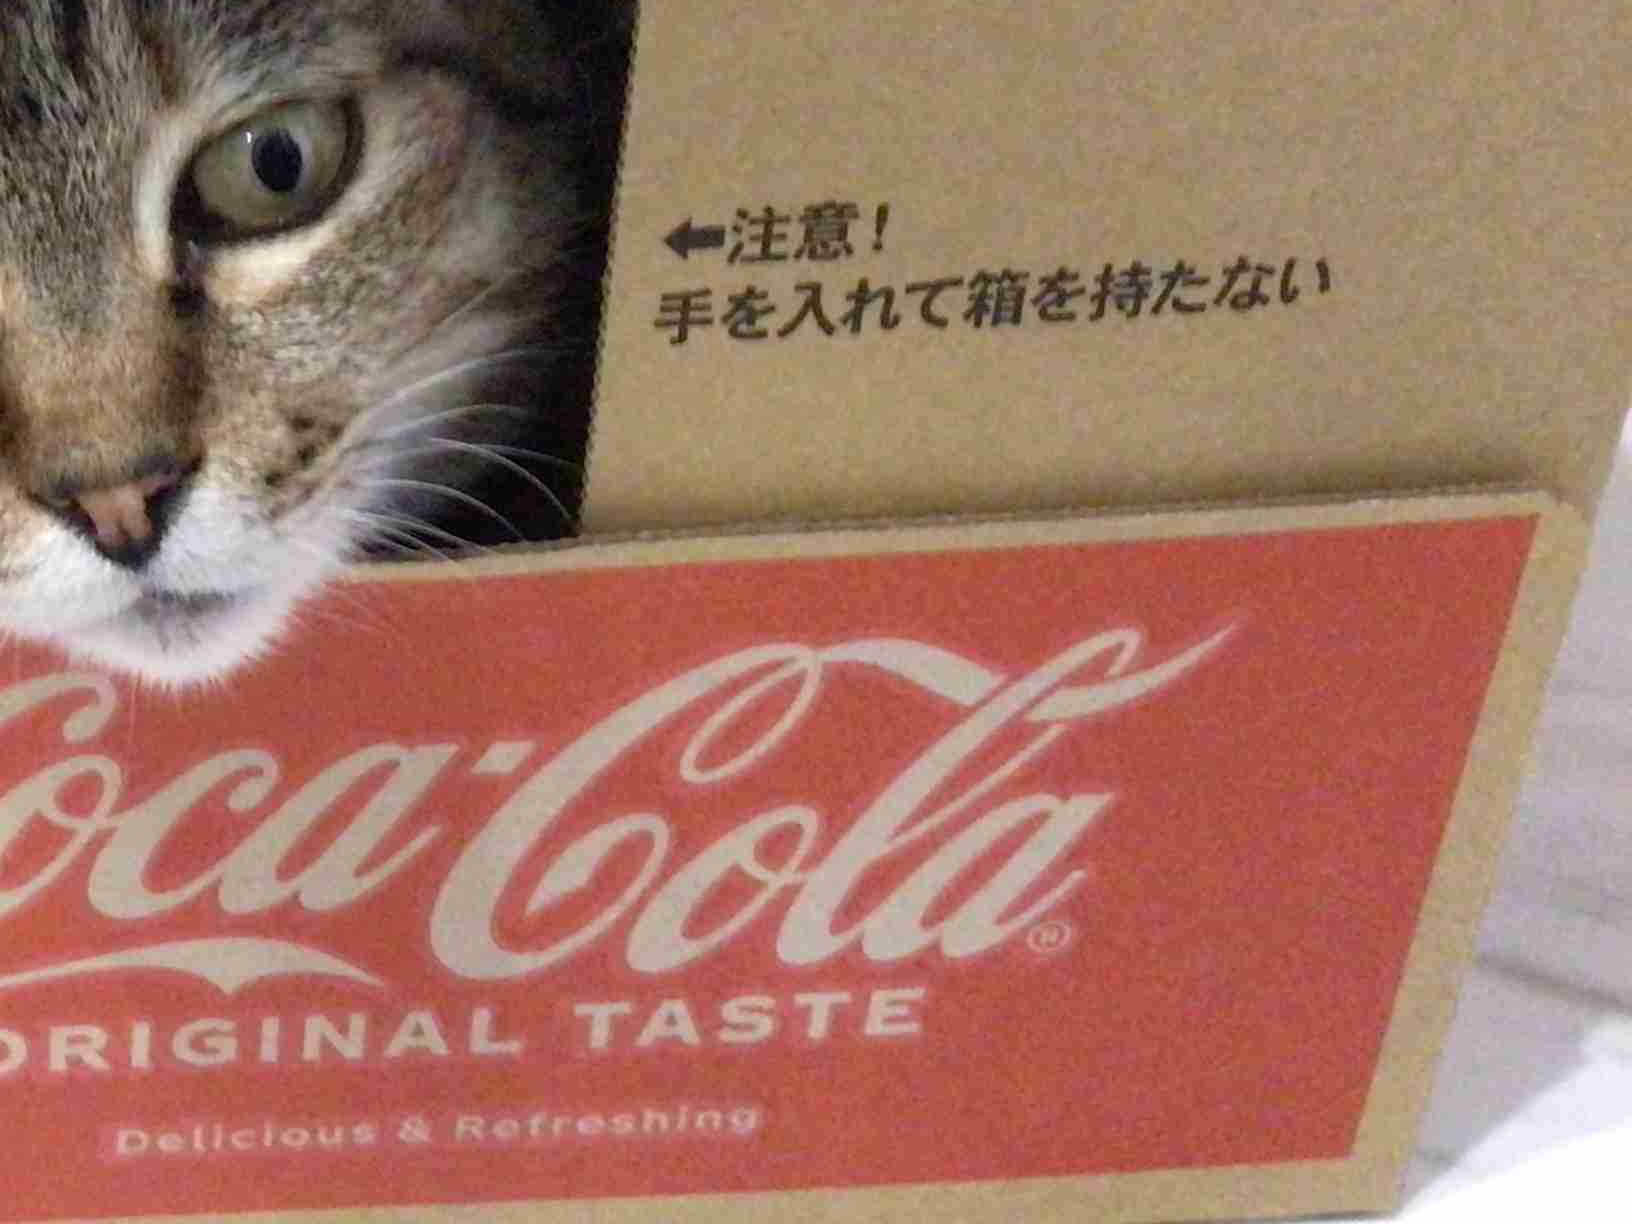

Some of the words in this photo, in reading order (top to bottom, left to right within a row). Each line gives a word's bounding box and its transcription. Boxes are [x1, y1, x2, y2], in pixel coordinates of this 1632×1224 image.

[726, 200, 891, 265] 注意!
[654, 254, 1332, 345] 手を入れて箱を持たない
[574, 987, 927, 1050] TASTE
[114, 1119, 378, 1156] Delicious
[397, 1116, 432, 1145] &
[454, 1105, 762, 1143] Refreshing
